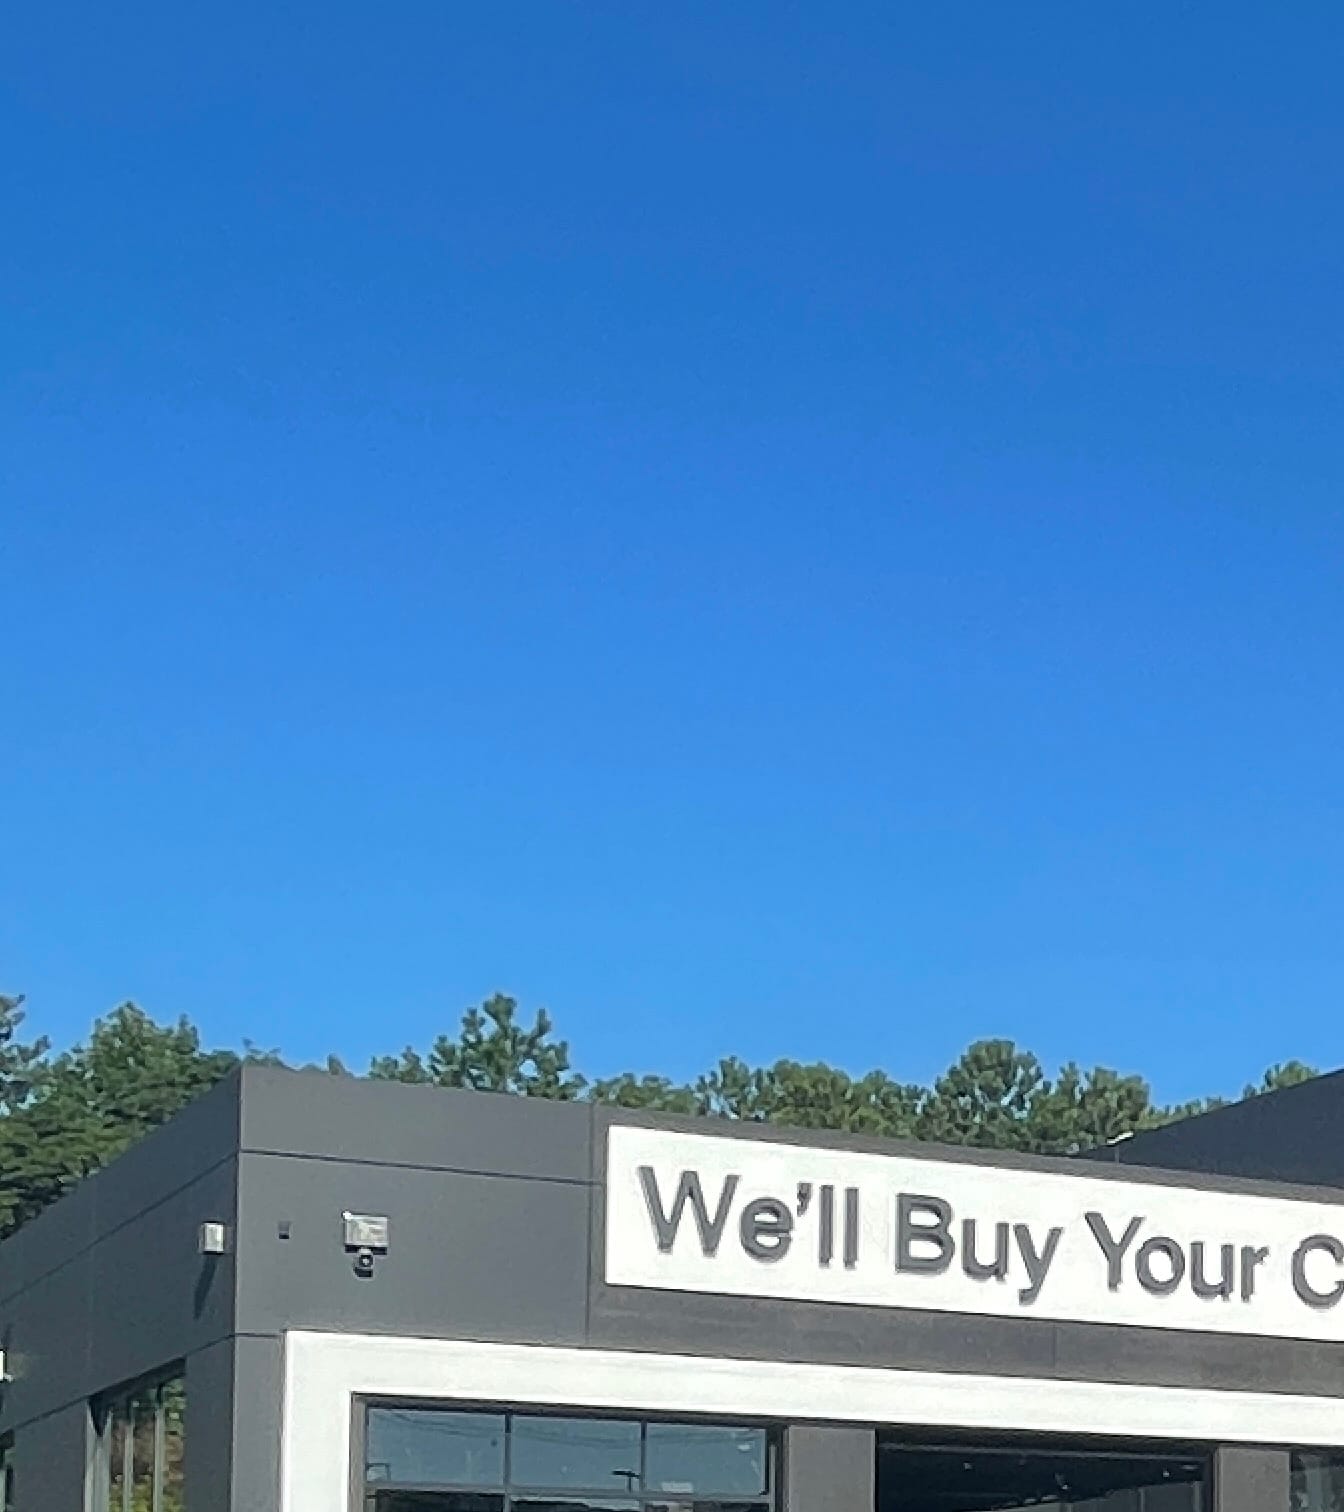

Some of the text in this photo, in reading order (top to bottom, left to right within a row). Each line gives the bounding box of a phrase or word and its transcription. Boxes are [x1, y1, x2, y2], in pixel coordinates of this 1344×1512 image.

[636, 1163, 860, 1270] We'll
[895, 1190, 1065, 1305] Buy
[1084, 1210, 1269, 1302] Your
